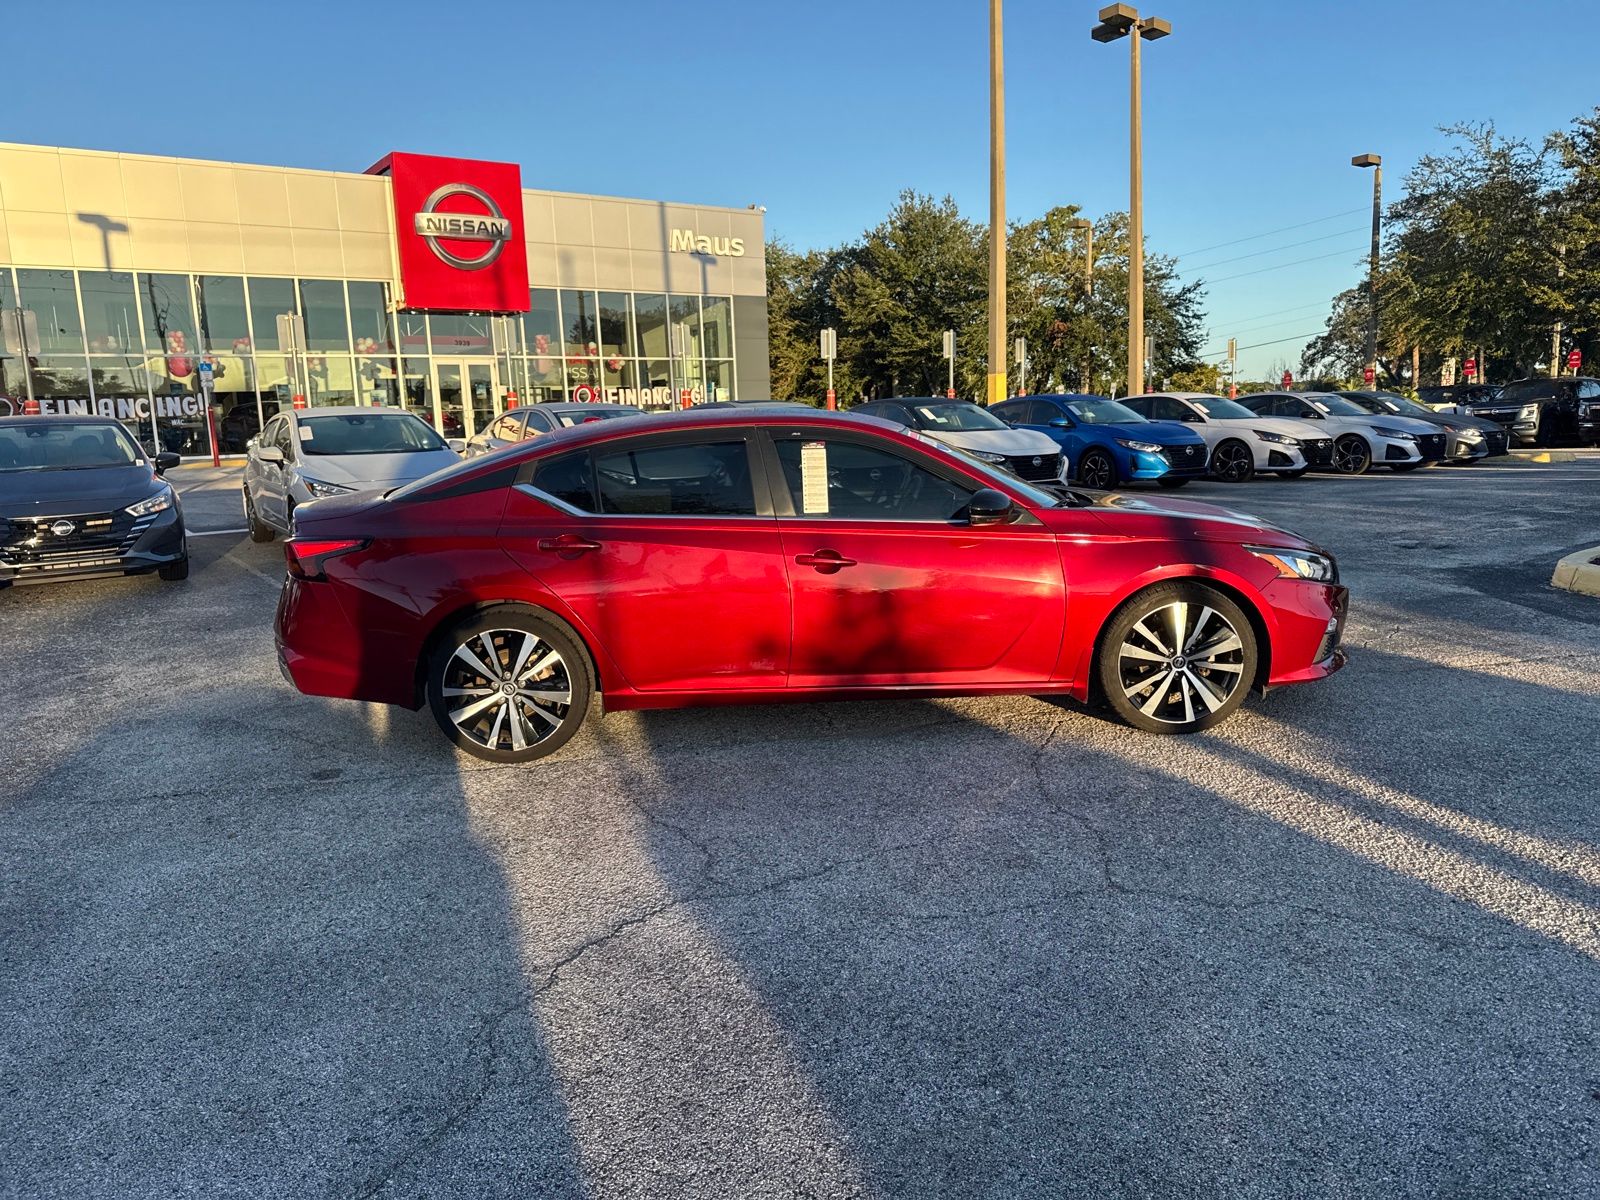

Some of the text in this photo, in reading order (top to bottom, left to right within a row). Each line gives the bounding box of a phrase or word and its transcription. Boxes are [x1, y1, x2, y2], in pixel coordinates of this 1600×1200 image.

[426, 217, 503, 237] NISSAN
[670, 228, 744, 257] Maus
[606, 385, 704, 405] FINANCIG!
